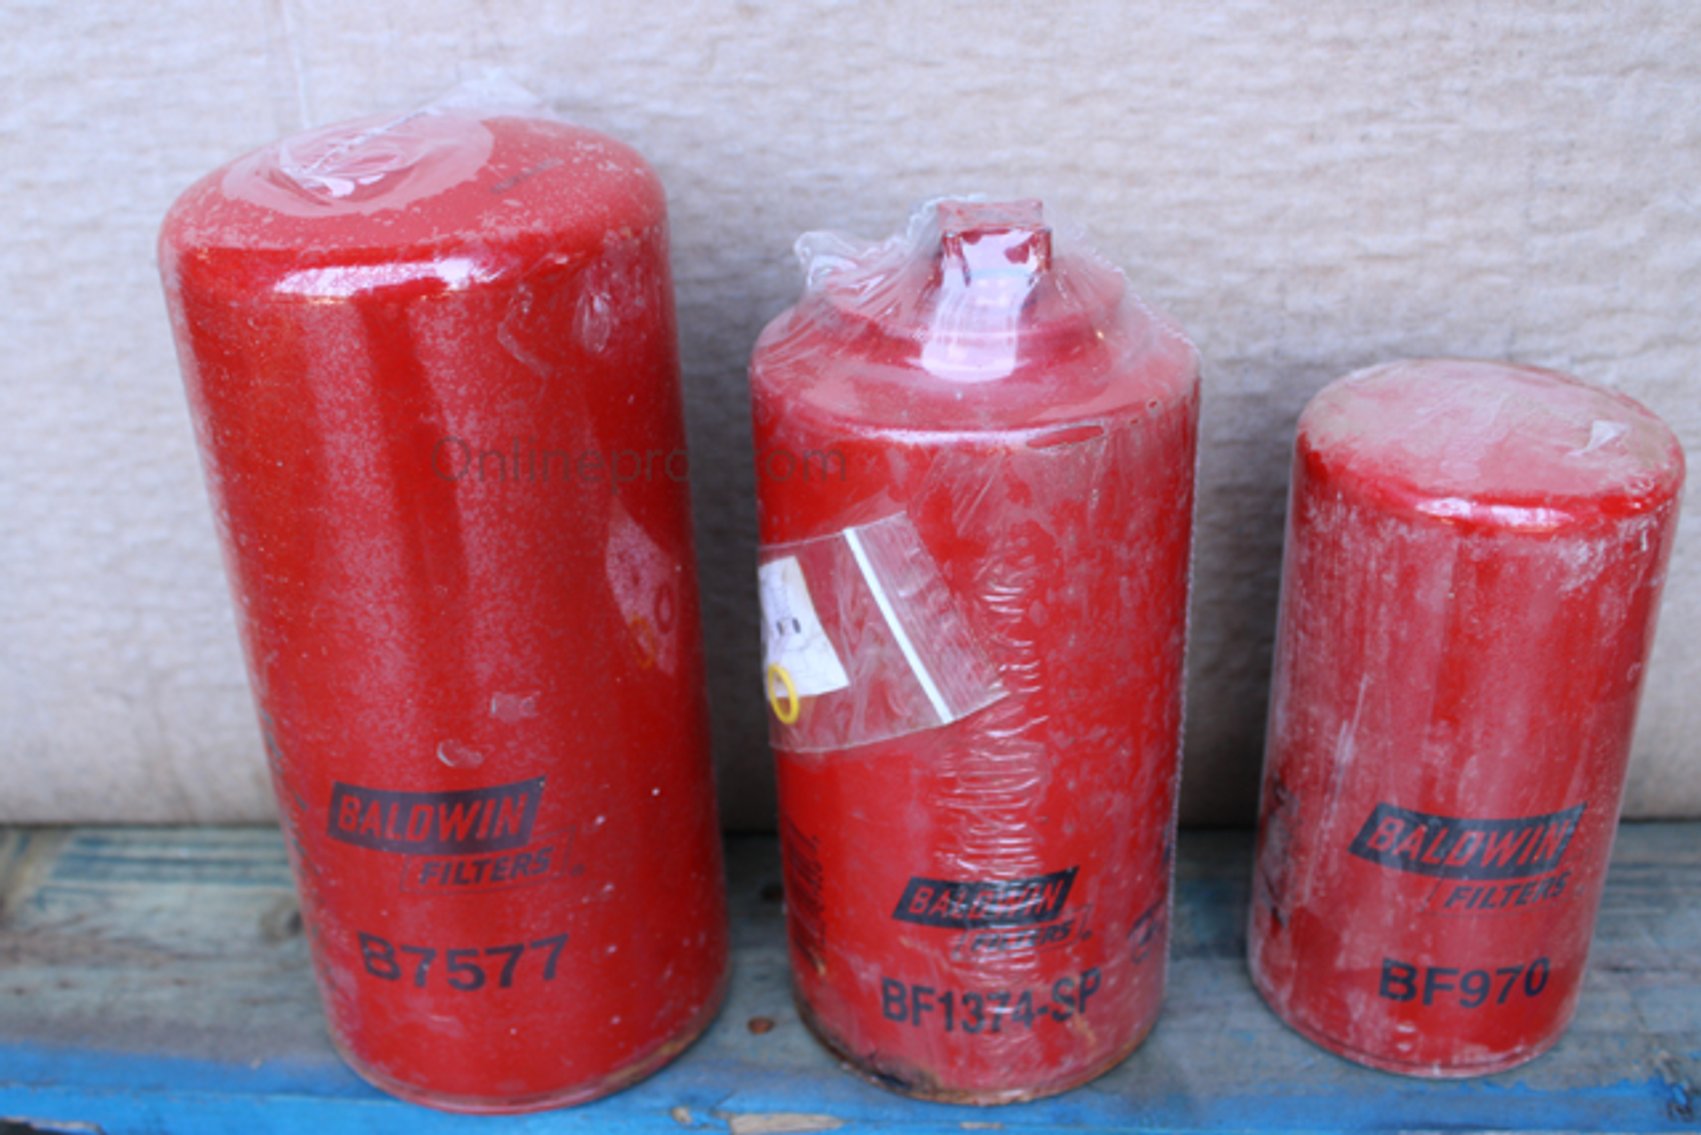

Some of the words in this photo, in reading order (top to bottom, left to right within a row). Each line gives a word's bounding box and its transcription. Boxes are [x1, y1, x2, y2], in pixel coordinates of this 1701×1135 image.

[337, 793, 527, 842] BALDWIN
[1366, 816, 1570, 867] BALDWIN
[419, 845, 553, 886] FILTERS
[1444, 871, 1572, 910] FILTERS
[910, 879, 1064, 920] BALDWIN
[357, 930, 569, 991] B7577
[1379, 956, 1550, 1009] BF970
[881, 967, 1101, 1034] BF1374-SP
